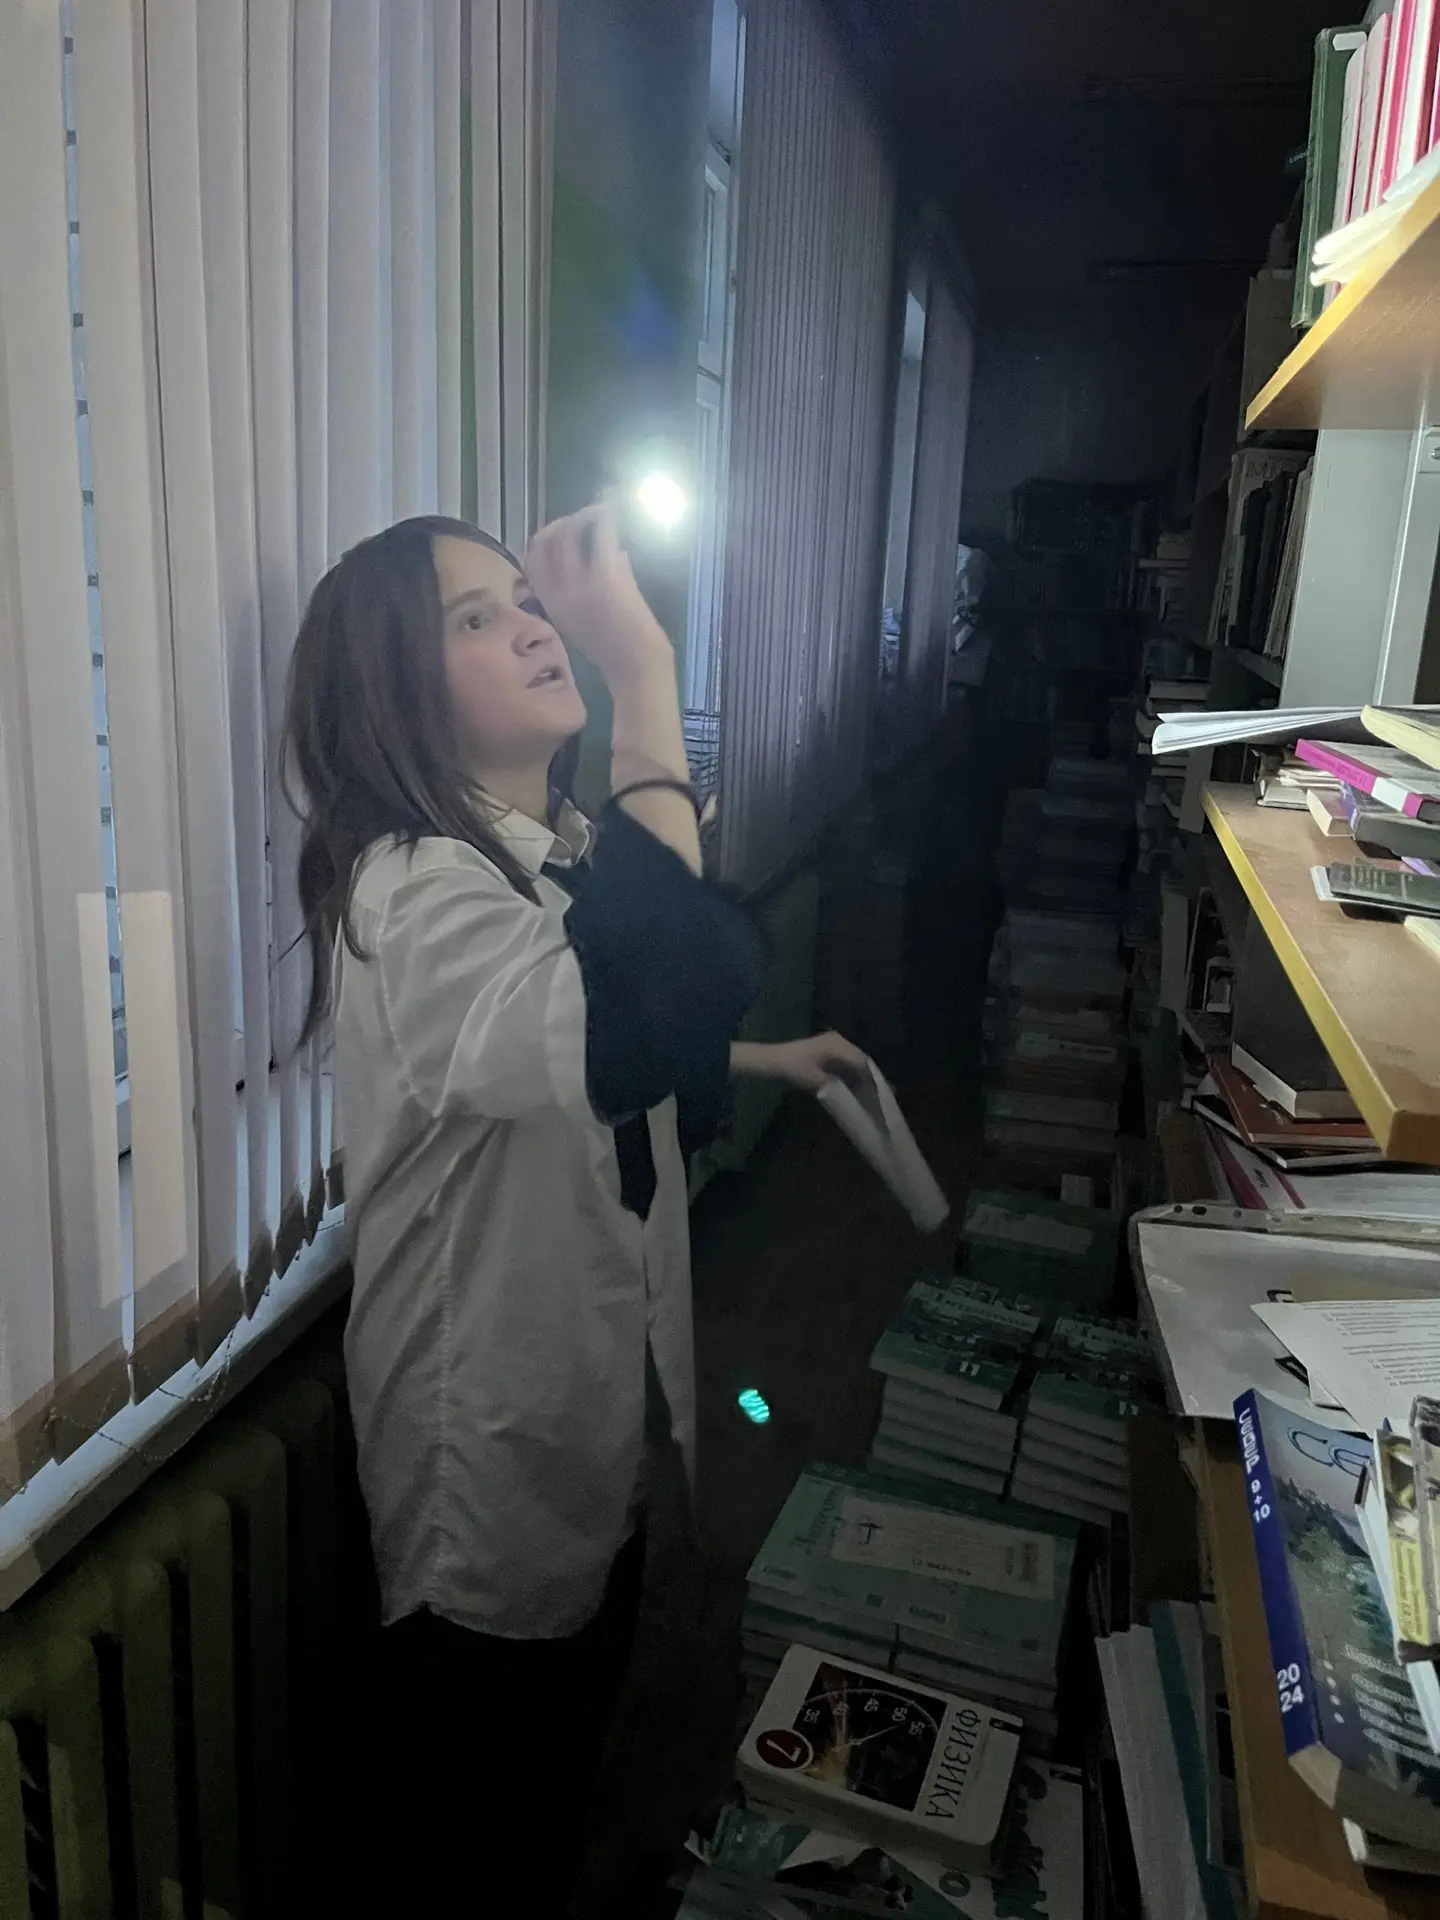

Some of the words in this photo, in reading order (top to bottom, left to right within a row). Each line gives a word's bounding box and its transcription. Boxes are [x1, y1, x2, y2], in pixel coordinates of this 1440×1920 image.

[1276, 1663, 1301, 1691] 20
[863, 1696, 879, 1713] 45
[1279, 1684, 1305, 1713] 24
[803, 1708, 820, 1724] 35
[891, 1706, 908, 1722] 50
[907, 1719, 925, 1736] 55
[765, 1739, 802, 1763] 7
[925, 1707, 979, 1820] ФИЗИКА
